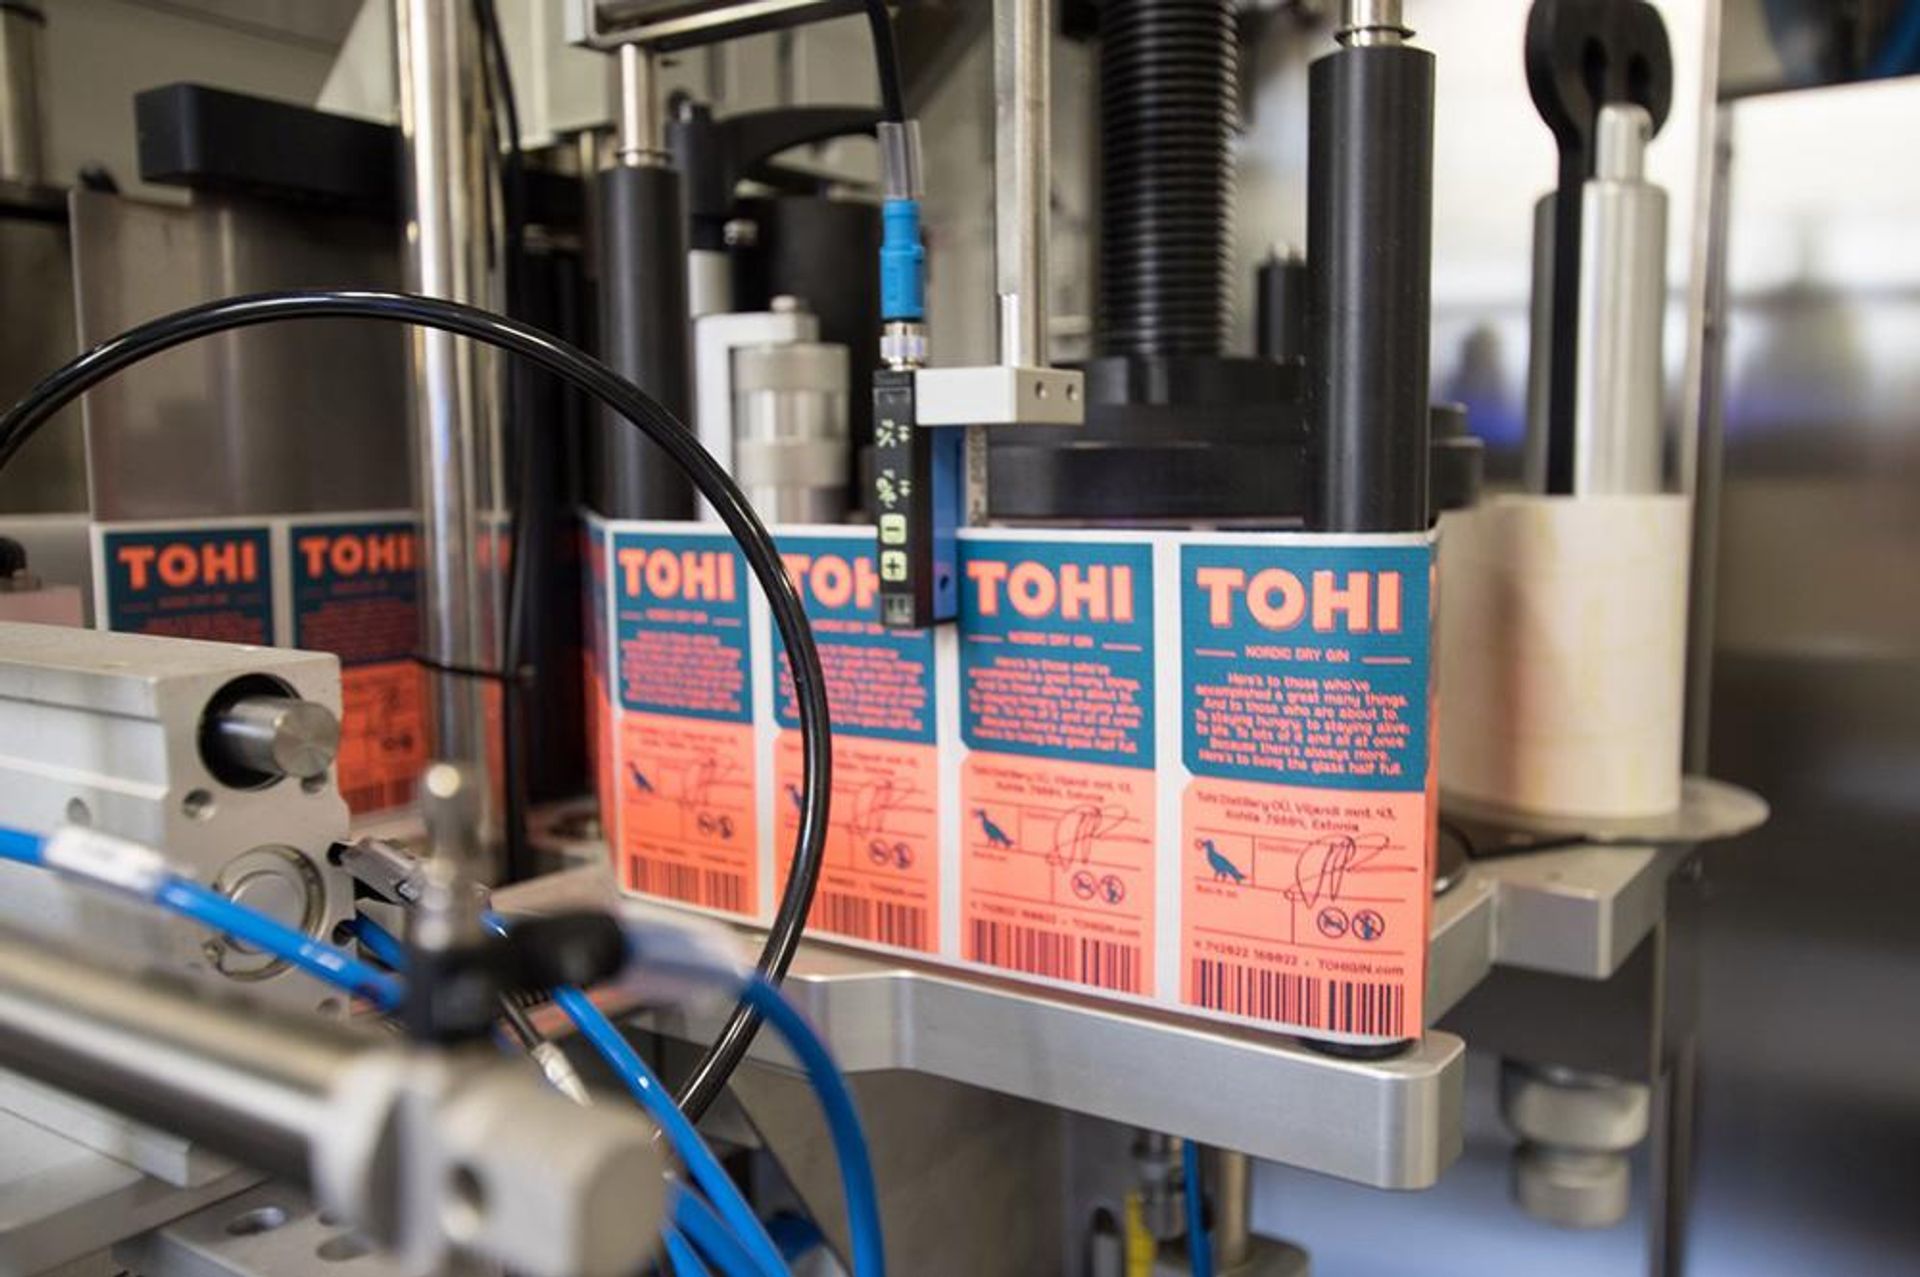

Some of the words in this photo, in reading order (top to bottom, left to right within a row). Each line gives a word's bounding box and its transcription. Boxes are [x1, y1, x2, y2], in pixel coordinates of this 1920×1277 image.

[118, 540, 258, 590] TOHI
[301, 532, 415, 577] TOHI
[618, 547, 736, 601] TOHI
[779, 553, 880, 609] TOH
[966, 559, 1134, 623] TOHI
[1196, 567, 1403, 634] TOHI
[1245, 645, 1292, 660] NORDIC
[1295, 647, 1322, 661] DRY
[1325, 648, 1350, 663] GIN
[1267, 674, 1280, 688] to
[1283, 676, 1318, 691] those
[1286, 690, 1319, 706] great
[1324, 692, 1361, 709] many
[1282, 703, 1310, 718] who
[1314, 705, 1335, 719] are
[1339, 706, 1377, 721] about
[1324, 720, 1372, 738] staying
